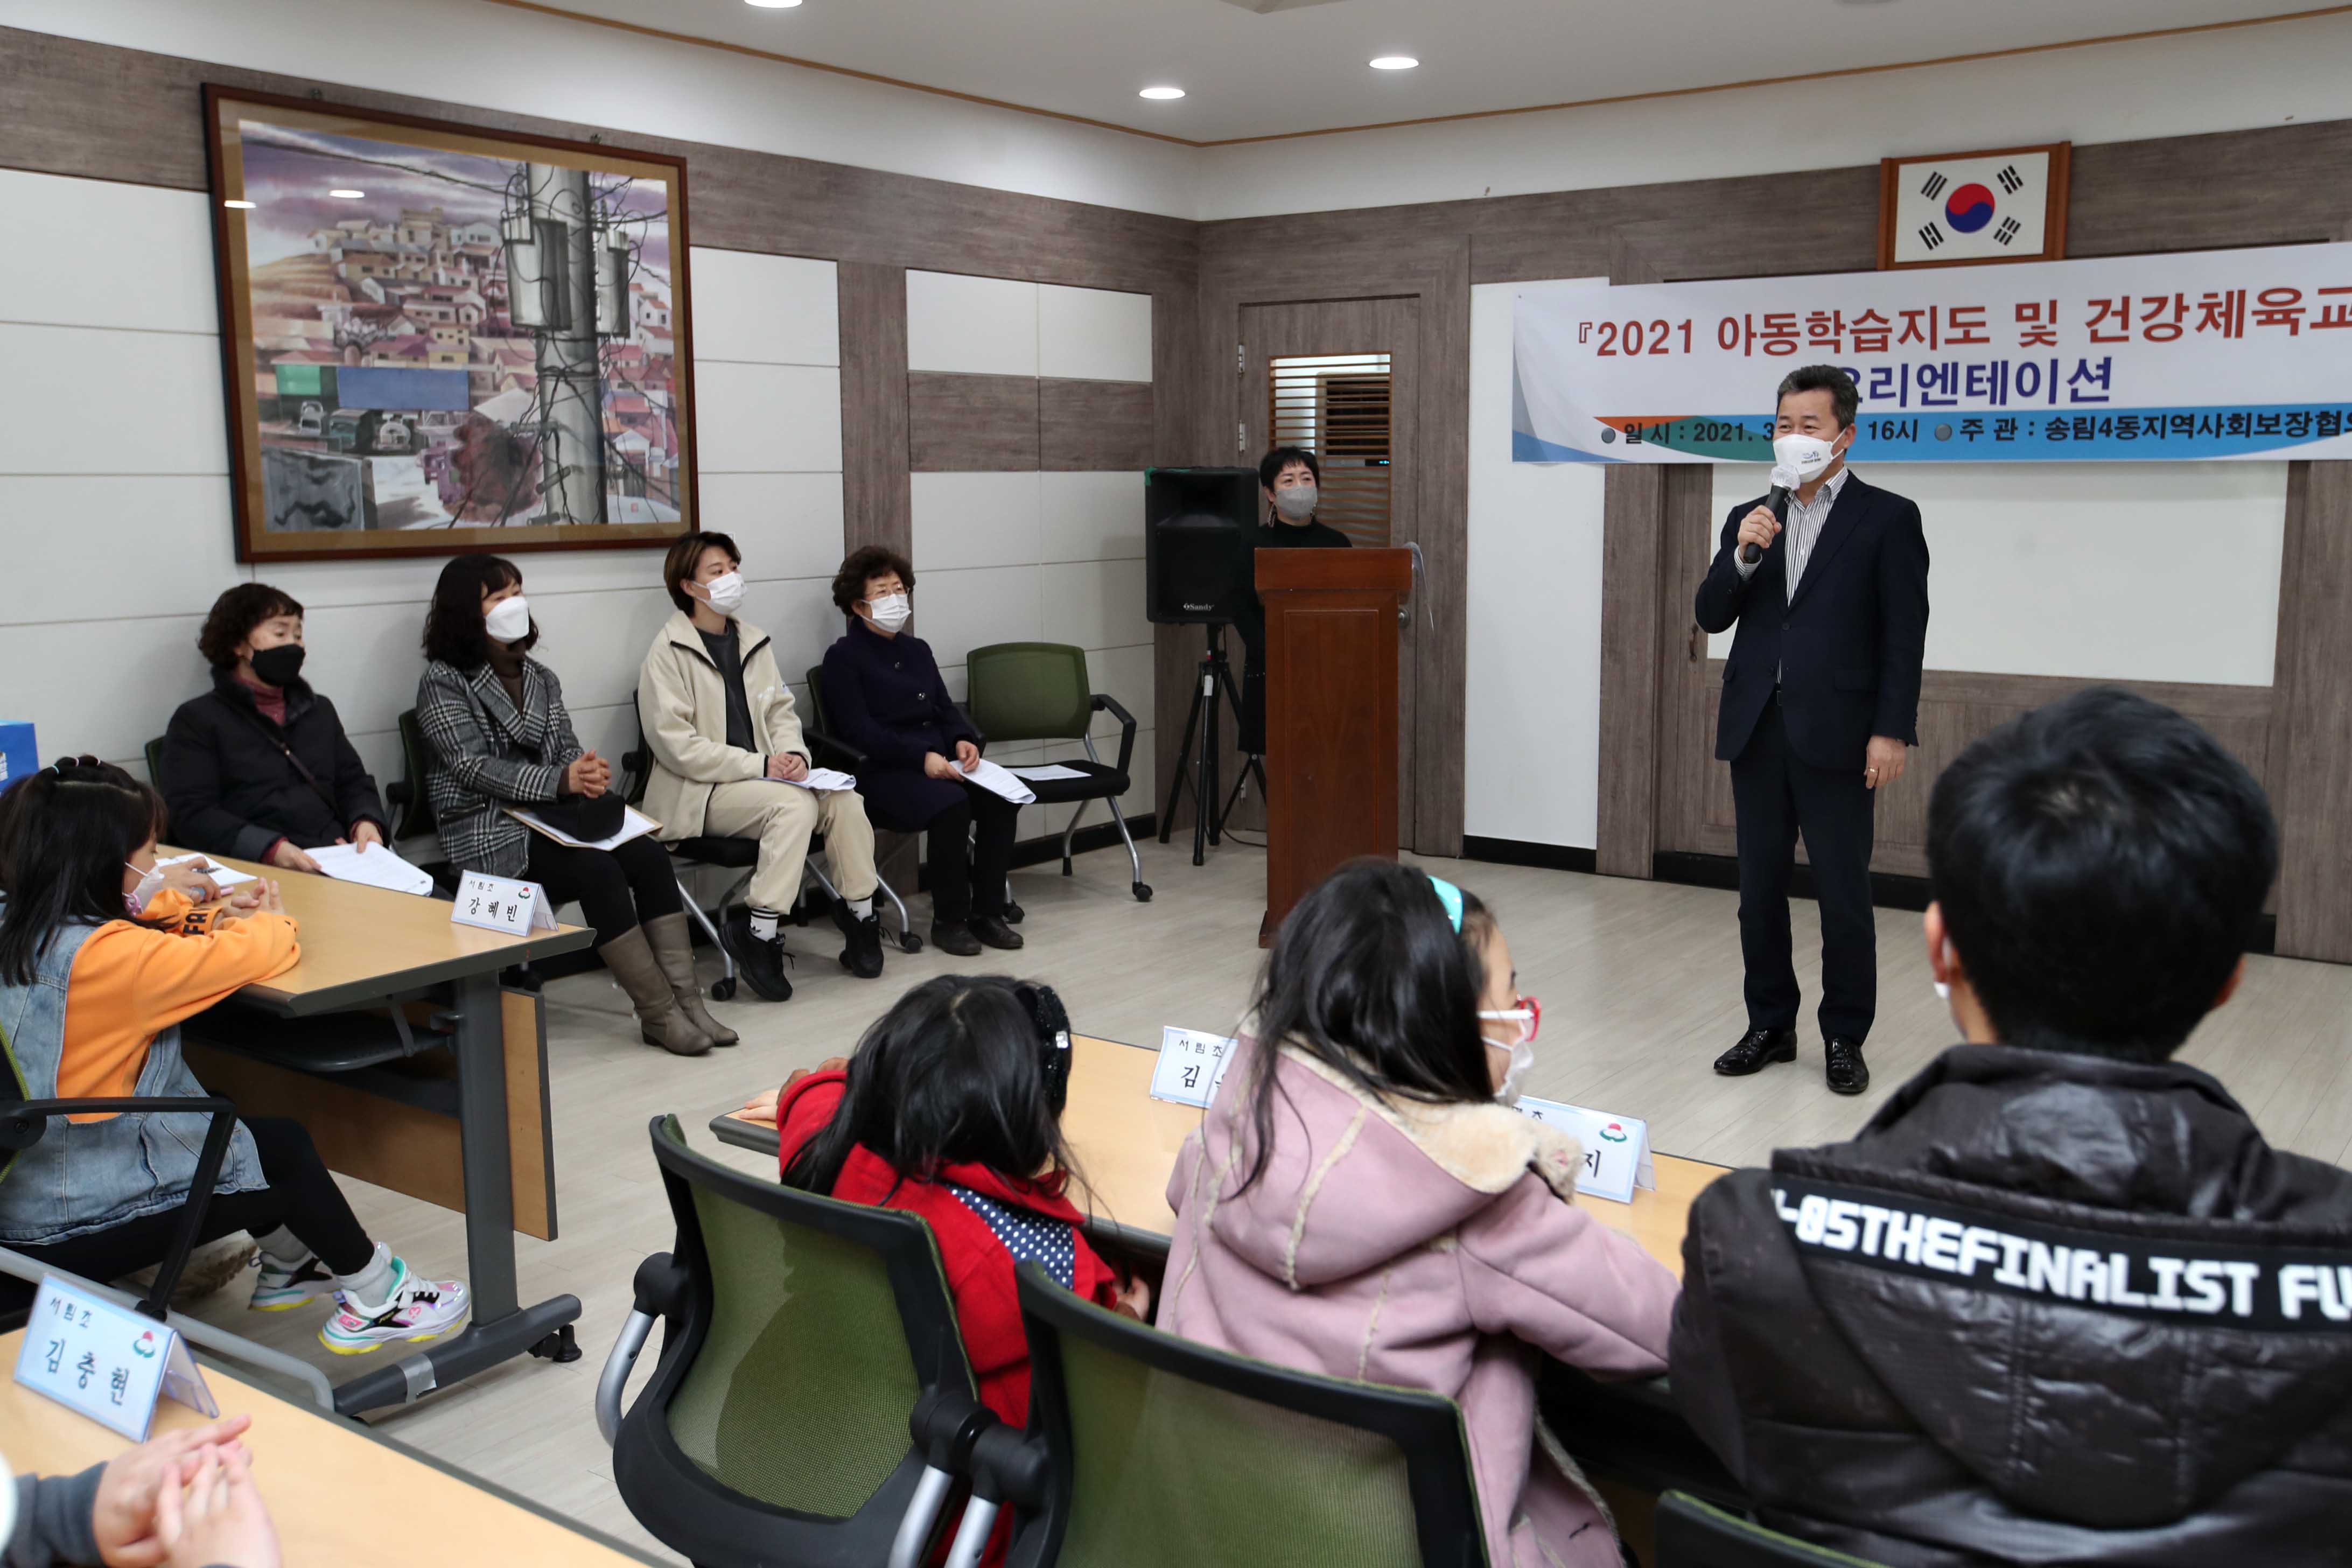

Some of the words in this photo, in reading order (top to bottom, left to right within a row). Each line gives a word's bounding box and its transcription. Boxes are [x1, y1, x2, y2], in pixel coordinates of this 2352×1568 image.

[1718, 305, 1991, 357] 아동학습지도
[2015, 299, 2059, 348] 및
[1868, 418, 1919, 443] 16시
